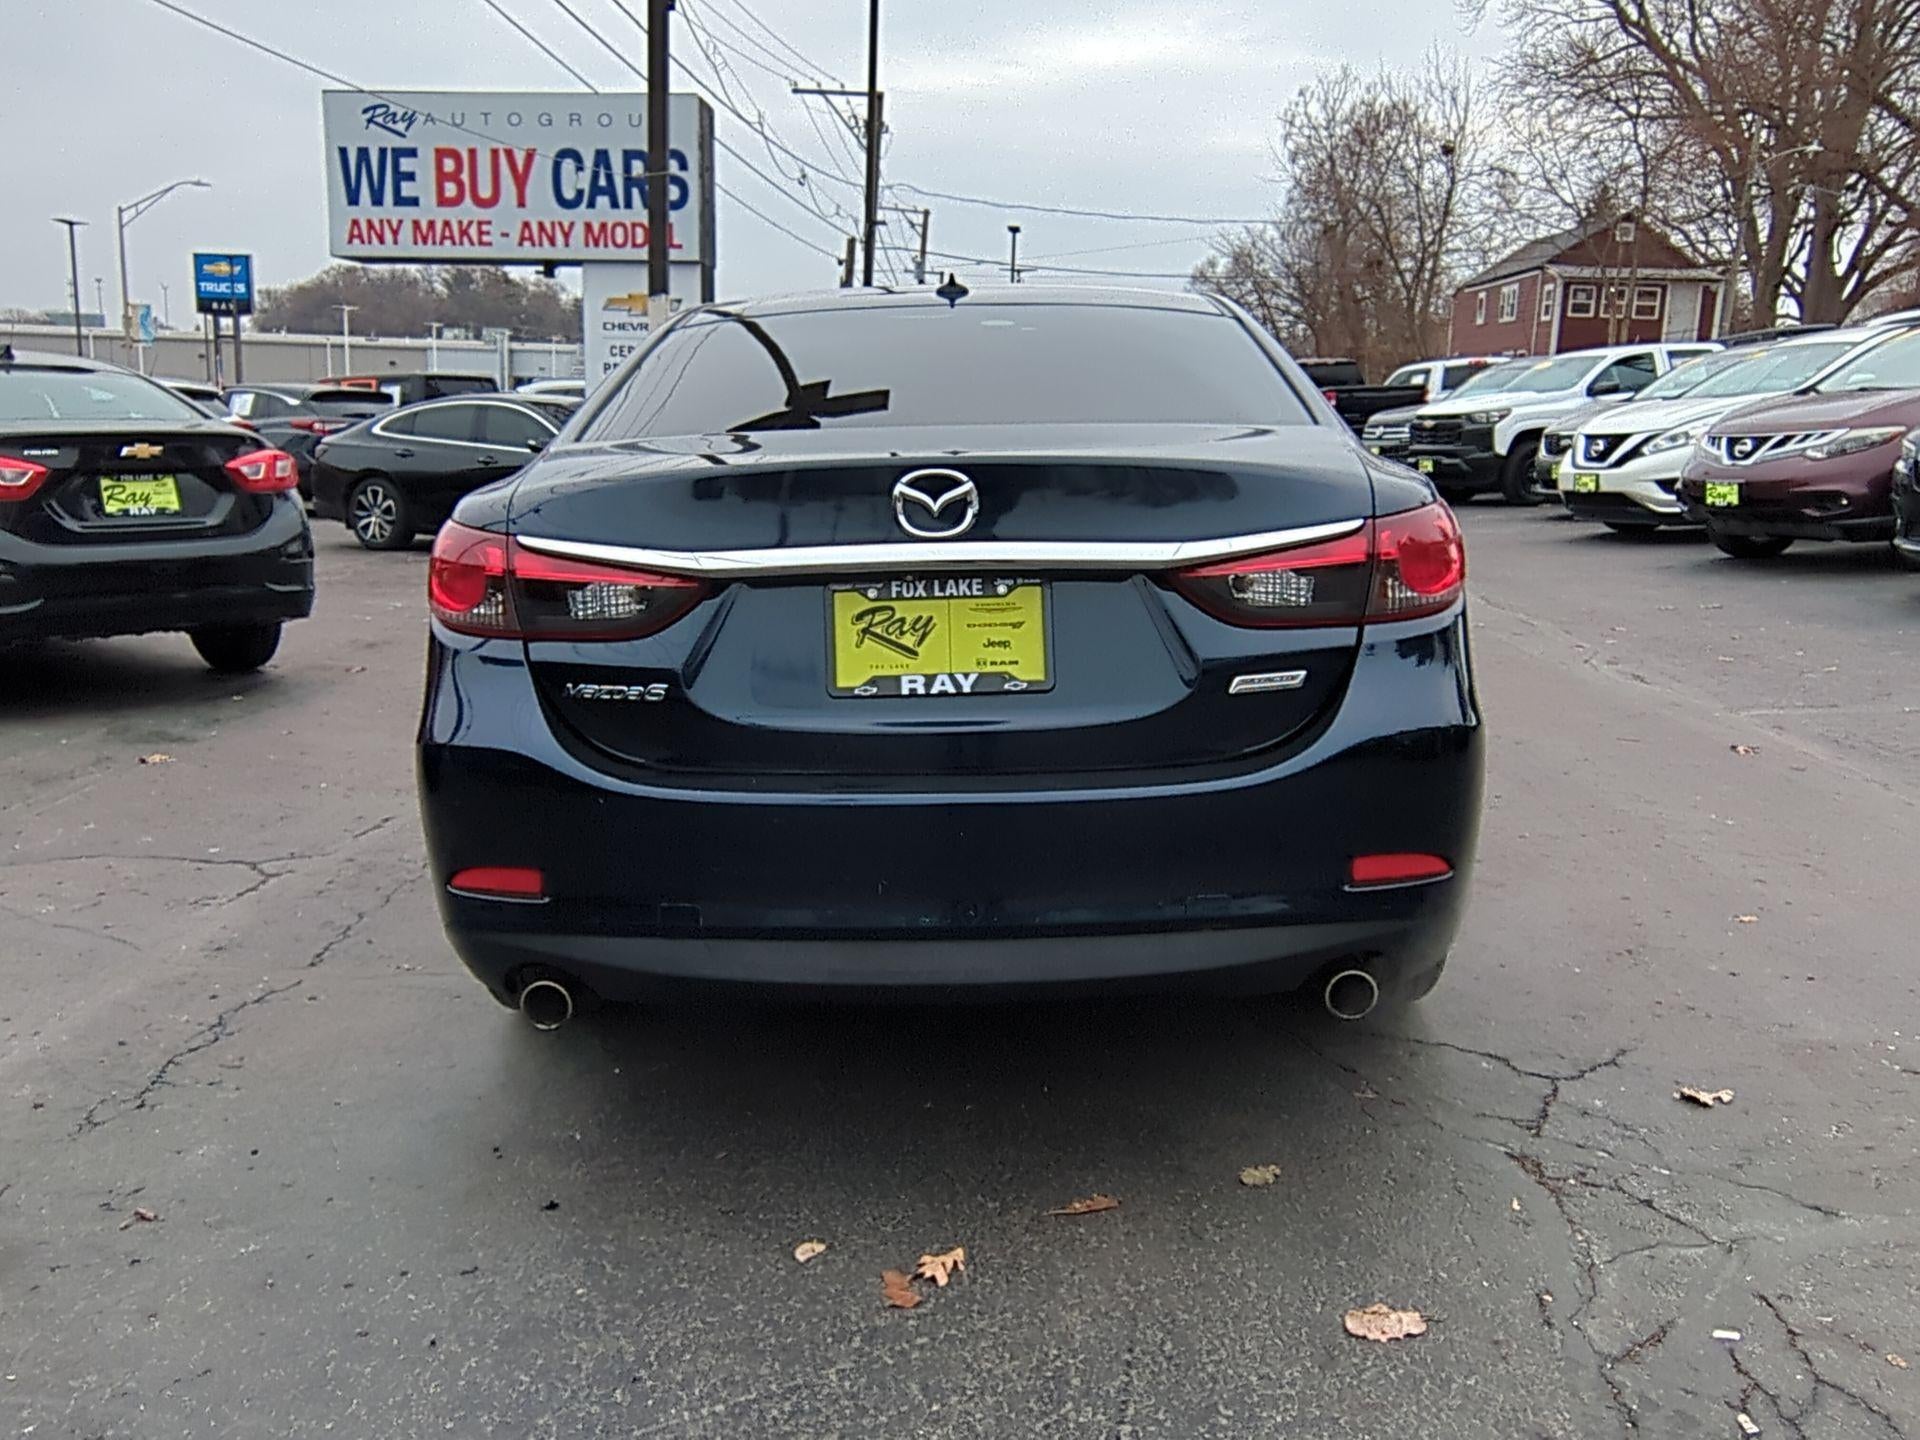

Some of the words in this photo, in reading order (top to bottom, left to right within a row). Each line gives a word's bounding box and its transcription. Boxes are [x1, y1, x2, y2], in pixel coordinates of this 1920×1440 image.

[361, 103, 418, 138] Ray
[422, 111, 643, 128] AUTOGROU
[338, 146, 420, 207] WE
[434, 147, 537, 209] BUY
[552, 147, 689, 211] CARS
[347, 218, 404, 245] ANY
[411, 218, 493, 246] MAKE
[517, 220, 575, 248] ANY
[583, 221, 683, 249] MODL
[103, 484, 152, 506] Ray
[891, 580, 927, 598] FOX
[933, 578, 983, 596] LAKE
[852, 605, 937, 660] Ray
[983, 638, 1012, 649] Jeep
[901, 673, 979, 695] RAY
